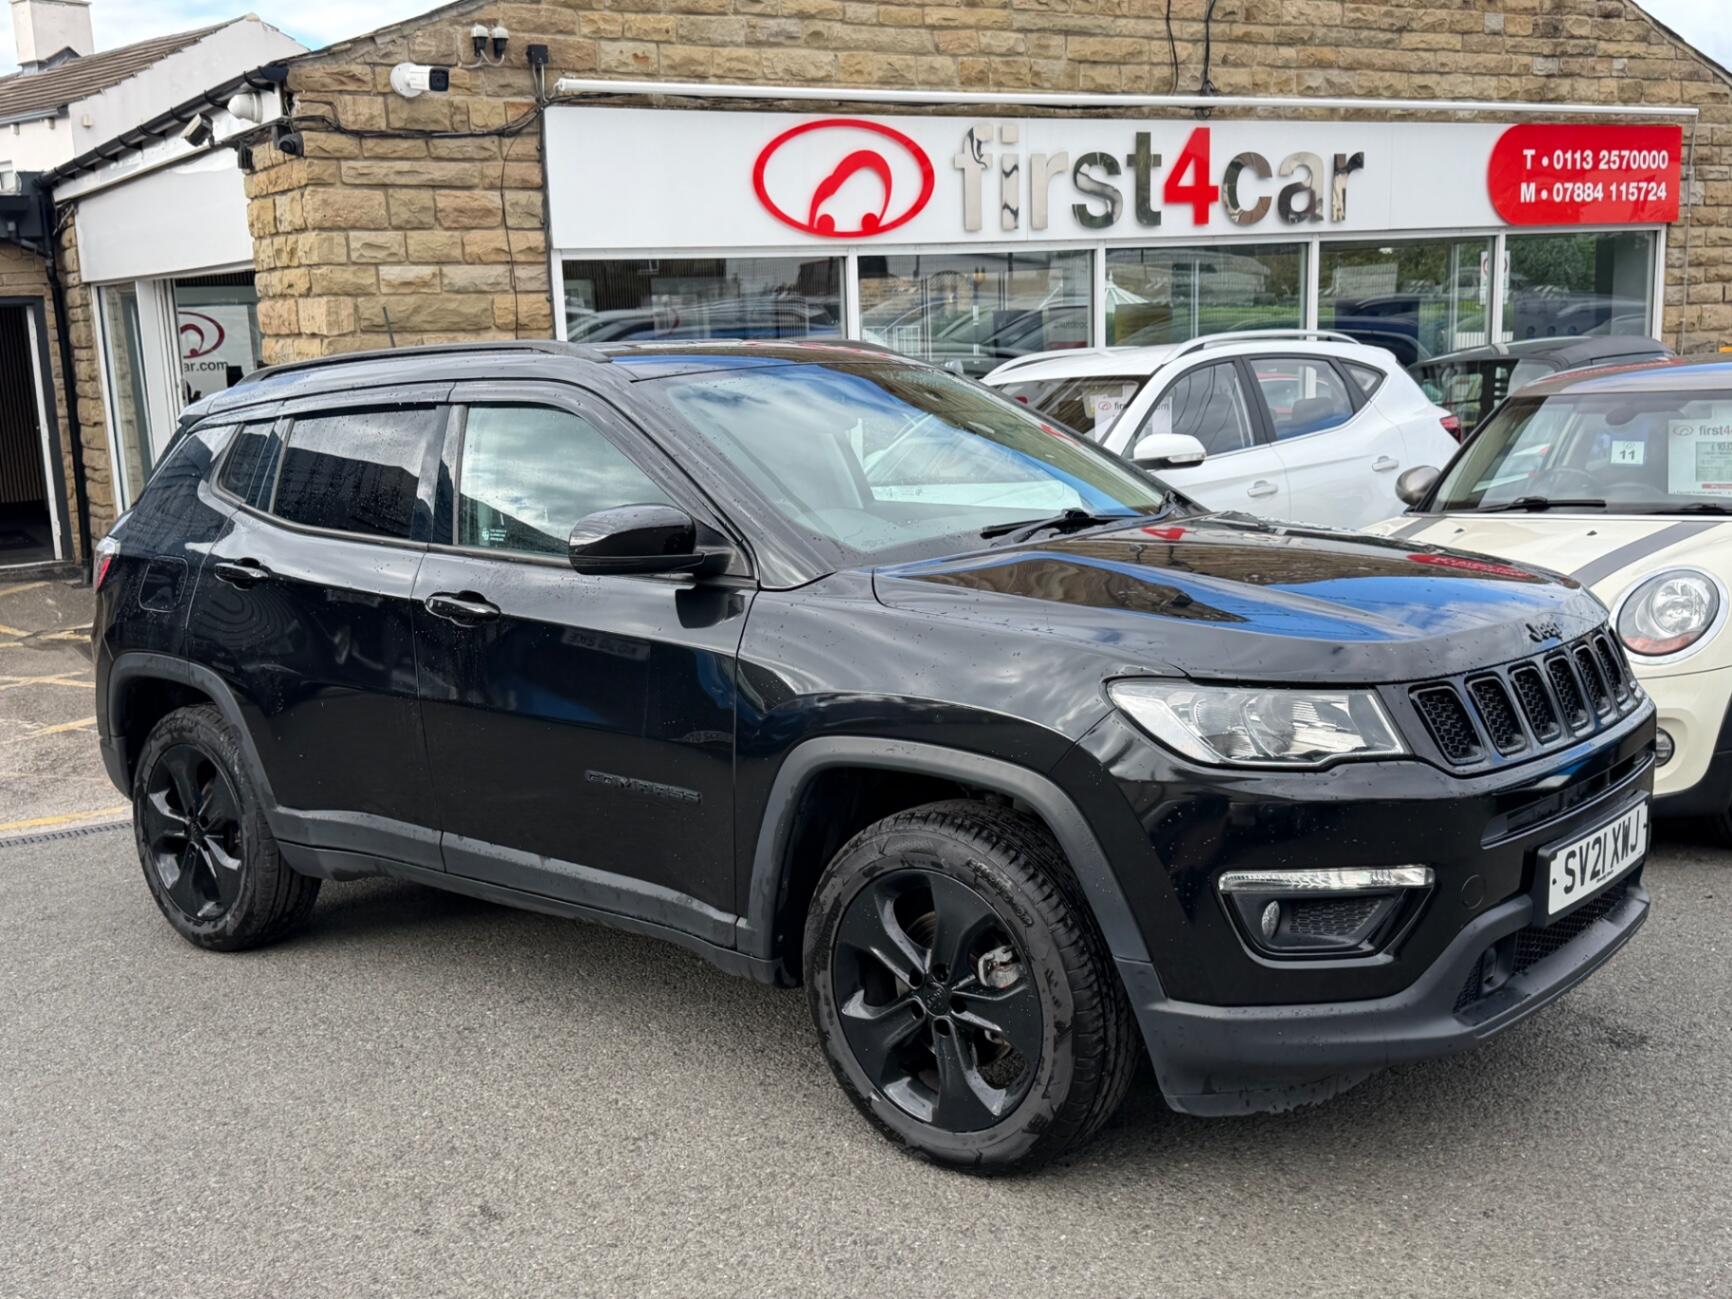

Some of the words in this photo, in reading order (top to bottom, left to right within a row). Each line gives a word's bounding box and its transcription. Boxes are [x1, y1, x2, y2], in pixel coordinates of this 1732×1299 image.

[1523, 149, 1536, 170] T
[1553, 149, 1593, 170] 0113
[1599, 149, 1669, 170] 2570000
[954, 124, 1365, 231] first4car
[1520, 182, 1536, 203] M
[1552, 181, 1604, 202] 07884
[1609, 181, 1667, 201] 115724
[1699, 425, 1732, 436] first4
[1619, 449, 1636, 460] 11
